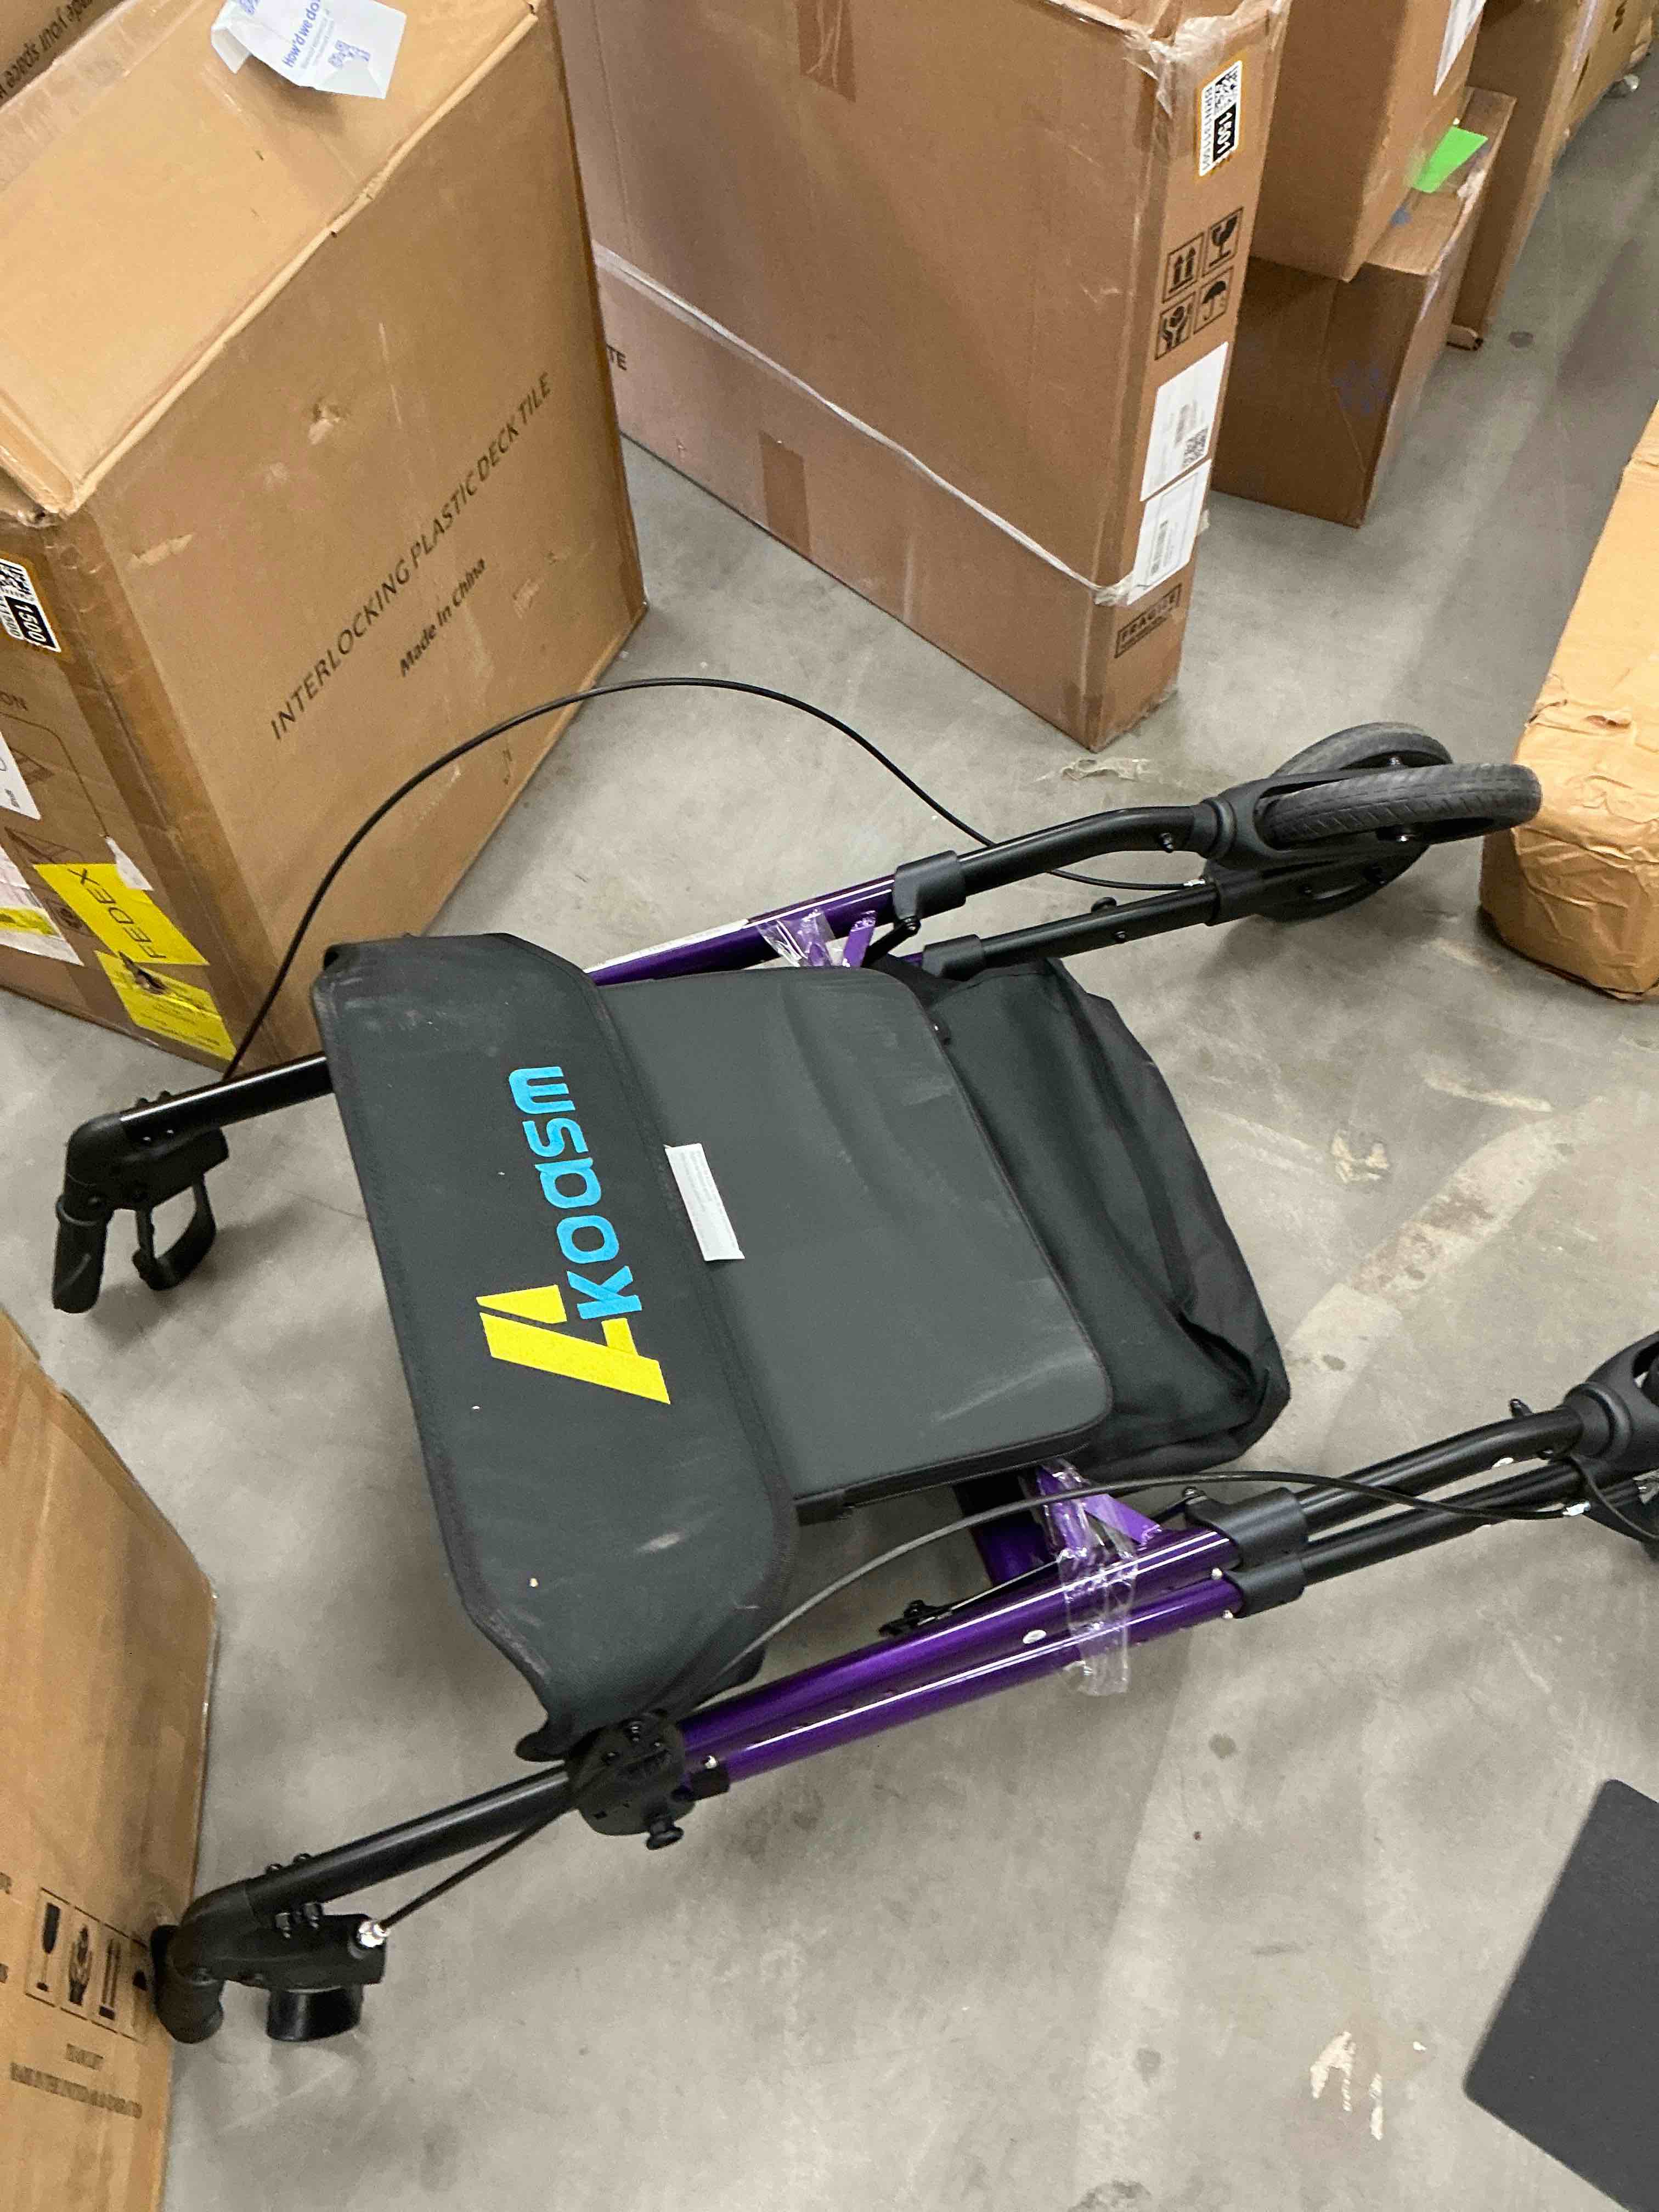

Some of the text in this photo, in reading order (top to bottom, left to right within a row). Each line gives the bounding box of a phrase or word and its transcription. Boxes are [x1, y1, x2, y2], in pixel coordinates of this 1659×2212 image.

[298, 19, 313, 36] we
[306, 0, 320, 21] do
[1218, 112, 1233, 155] 1501
[606, 343, 628, 371] TE
[271, 371, 551, 740] INTERLOCKING PLASTIC DECK TILE
[14, 604, 47, 642] 1500
[400, 624, 437, 678] Made
[452, 558, 486, 608] China
[67, 867, 167, 959] FEDEX
[508, 1065, 642, 1321] koasm
